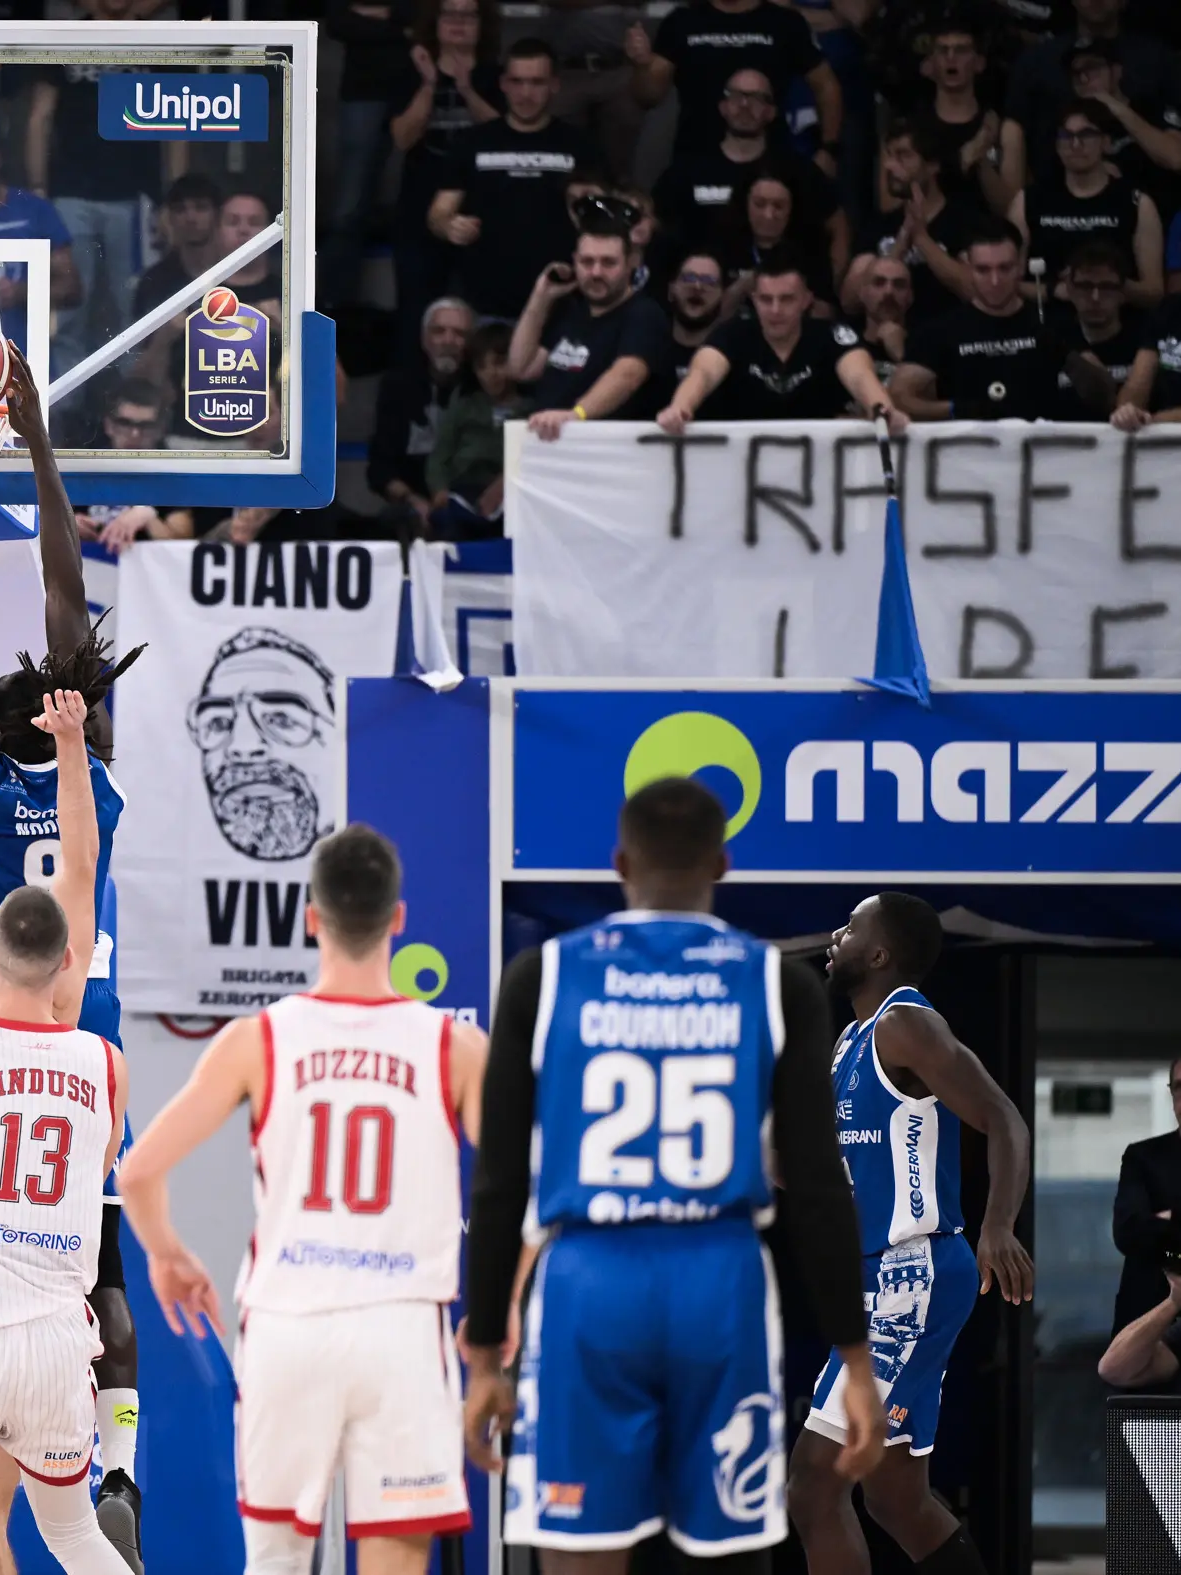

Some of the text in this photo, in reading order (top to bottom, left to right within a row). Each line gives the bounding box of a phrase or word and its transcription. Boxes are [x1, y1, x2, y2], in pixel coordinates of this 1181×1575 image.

[135, 82, 241, 131] Unipol
[198, 348, 260, 372] LBA
[208, 375, 248, 385] SERIE A
[204, 398, 254, 421] Unipol
[636, 433, 1181, 563] TRASFE
[190, 541, 373, 612] CIANO
[221, 968, 308, 985] BRIGATA
[294, 1047, 418, 1098] RUZZIER
[578, 1050, 736, 1190] 25
[302, 1101, 396, 1216] 10
[909, 1114, 924, 1191] GERMANI
